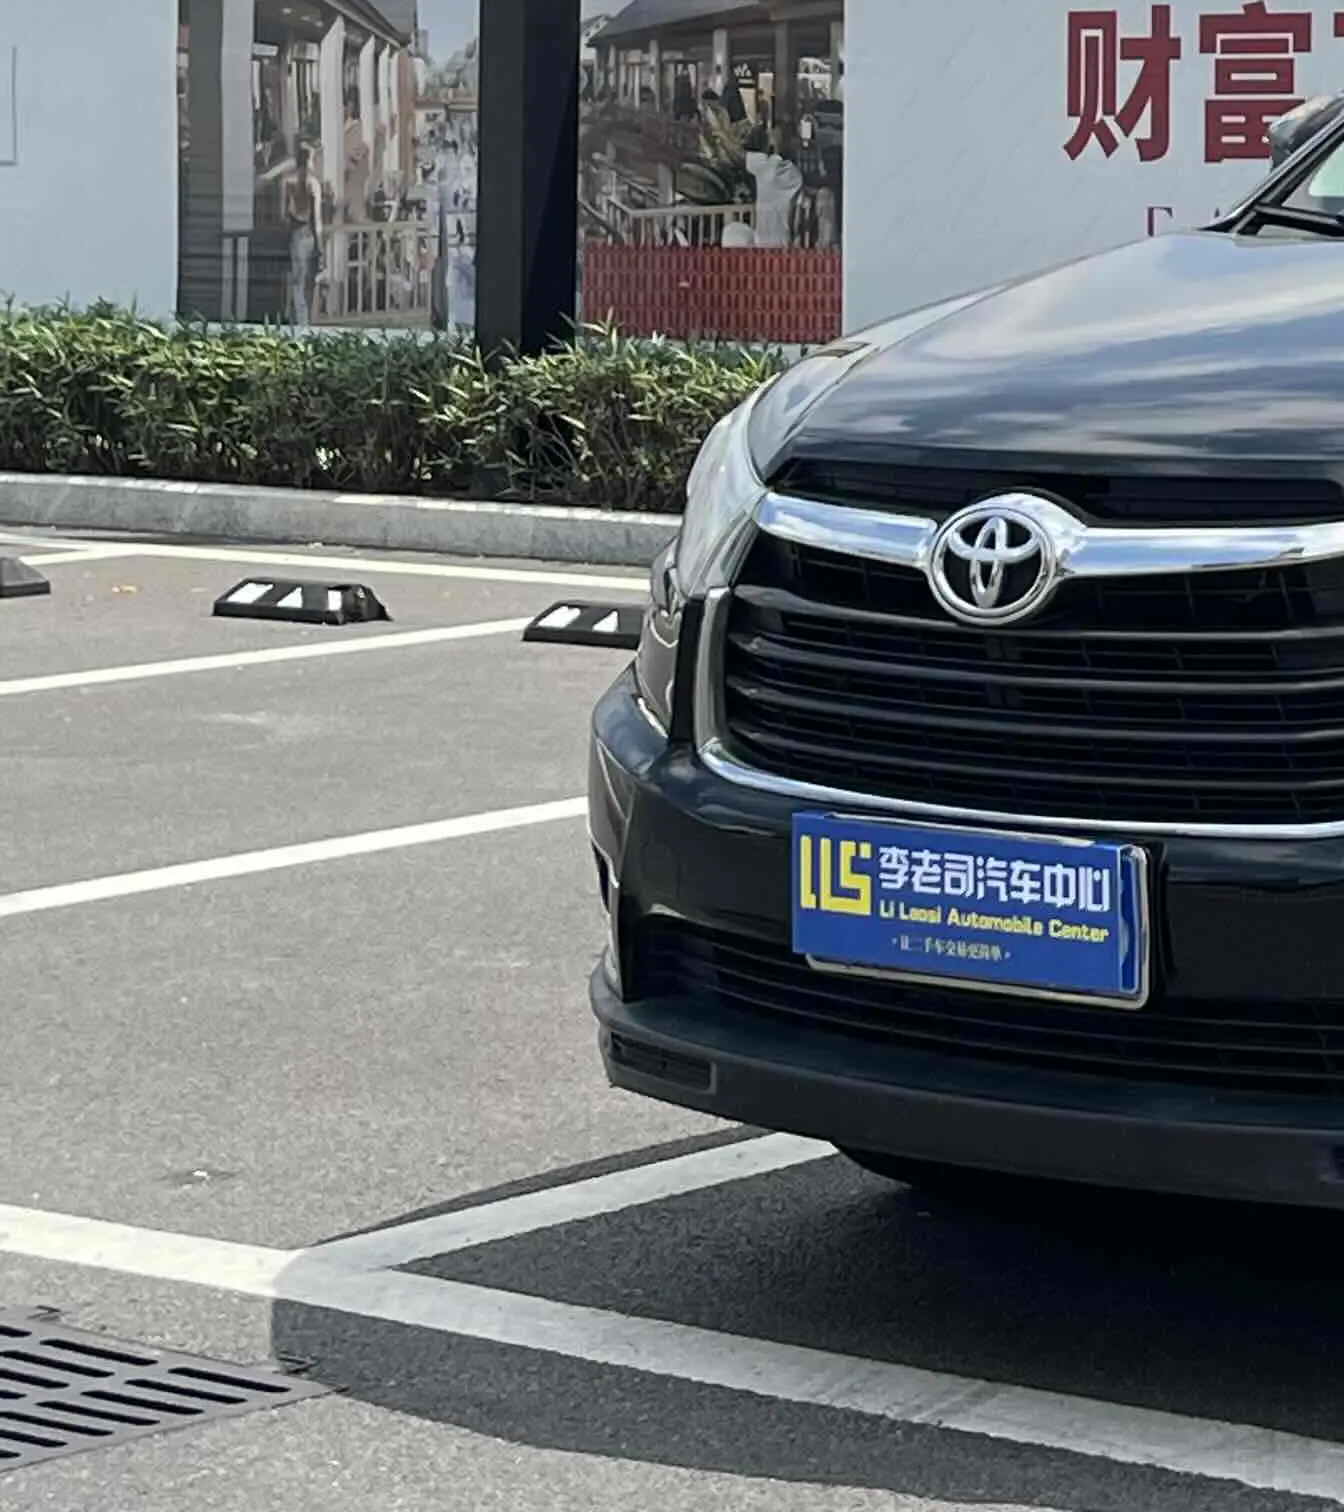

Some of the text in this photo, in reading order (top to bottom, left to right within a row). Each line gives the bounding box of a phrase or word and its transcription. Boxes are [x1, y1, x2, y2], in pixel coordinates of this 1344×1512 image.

[878, 845, 1111, 913] 李老司汽车中心
[946, 907, 1044, 937] Automobile
[1048, 918, 1110, 944] Center
